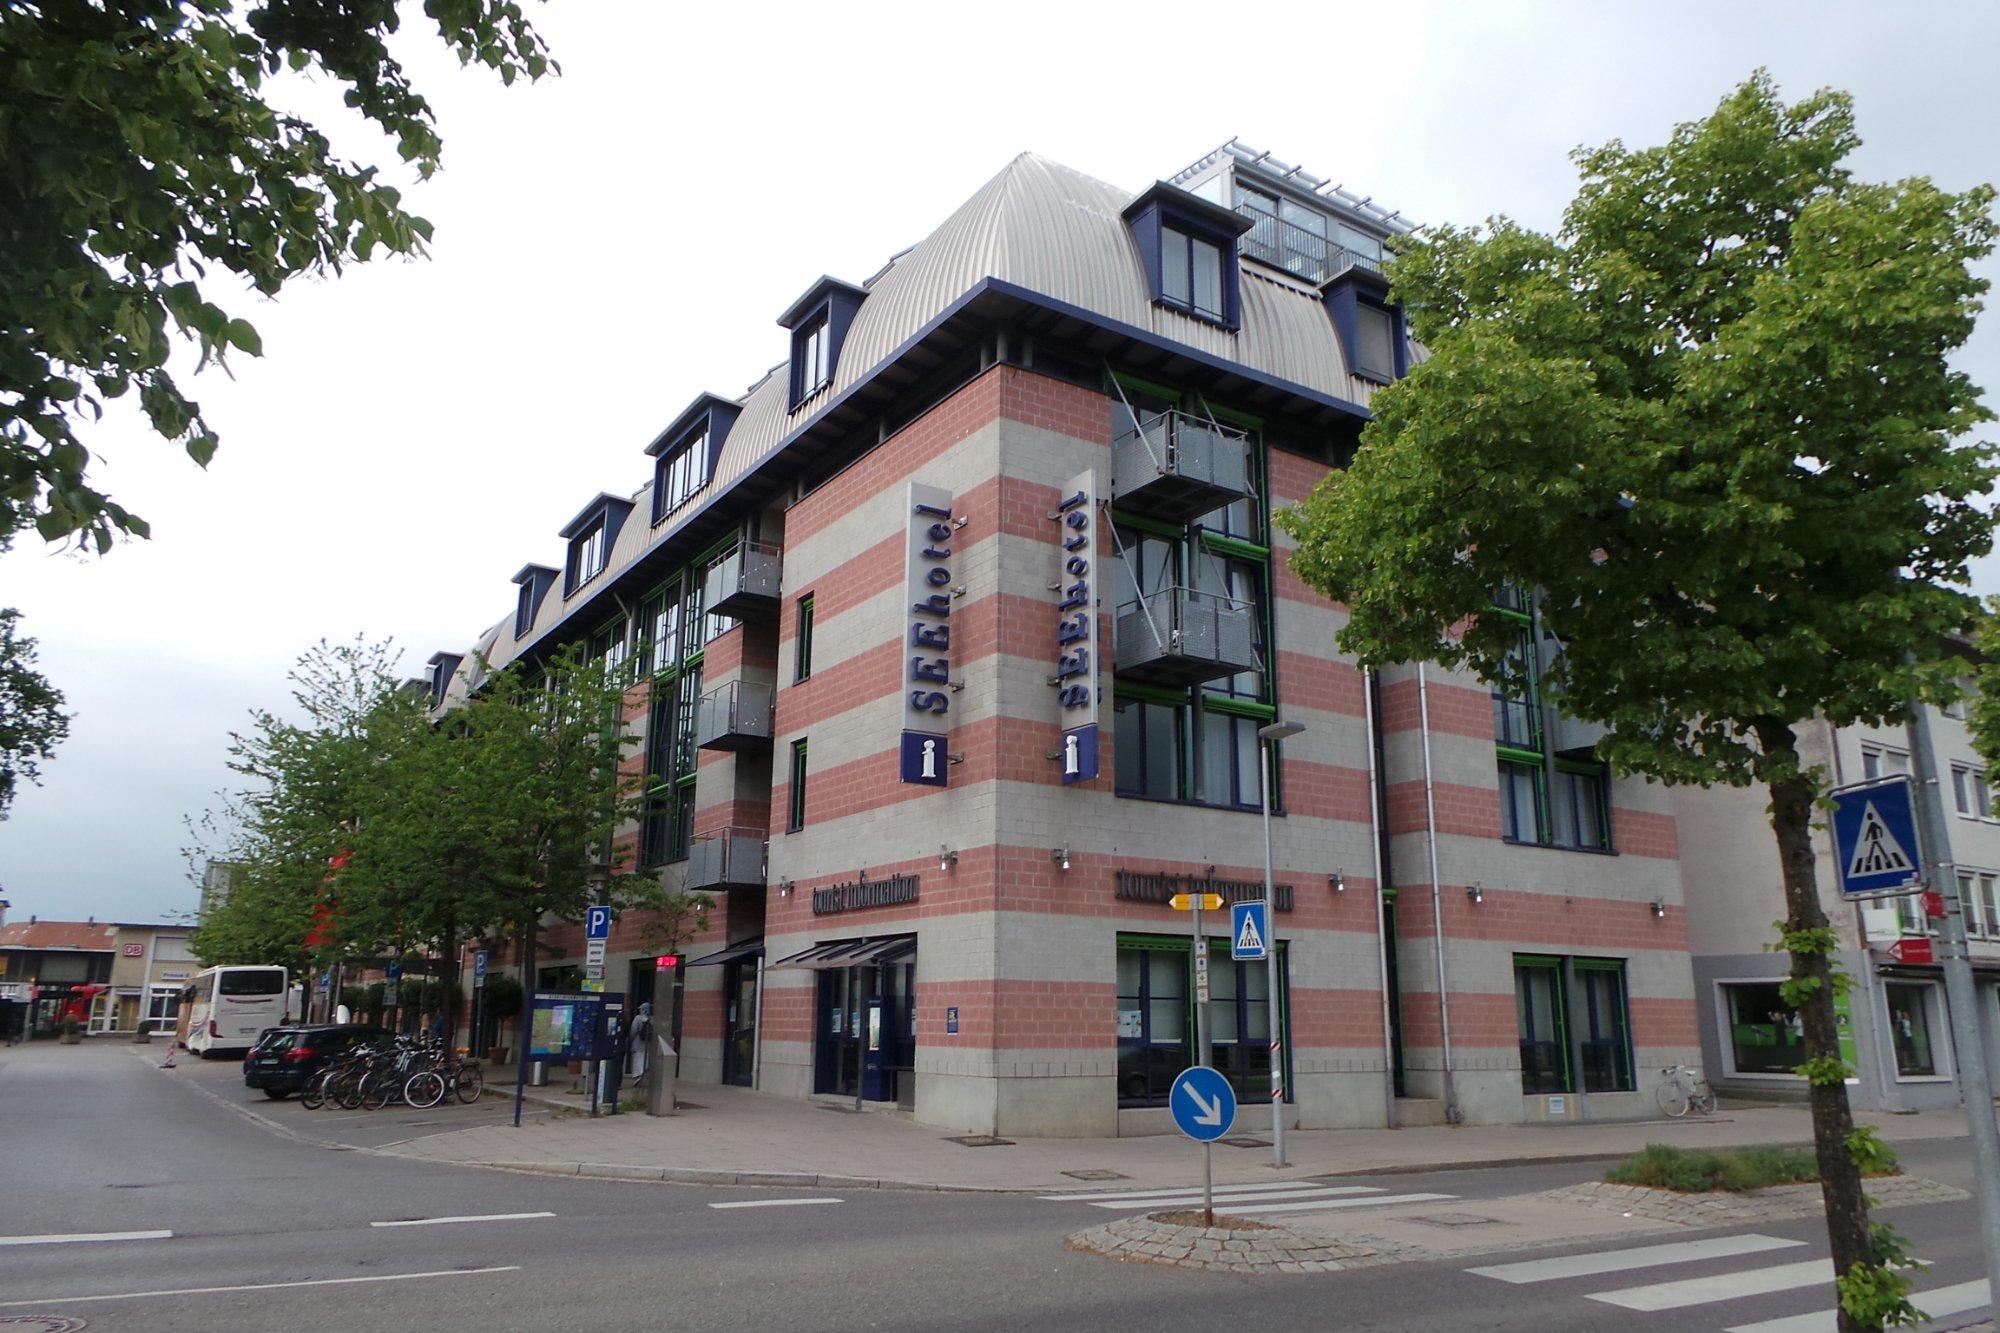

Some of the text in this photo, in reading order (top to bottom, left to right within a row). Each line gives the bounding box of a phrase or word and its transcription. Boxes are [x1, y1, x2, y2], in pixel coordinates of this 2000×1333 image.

[912, 504, 952, 714] SEEhotel
[1056, 490, 1088, 708] SEEhotel
[921, 739, 936, 777] i
[1065, 735, 1079, 774] i
[813, 870, 918, 916] tourist information
[591, 910, 605, 935] P
[125, 945, 142, 955] DB
